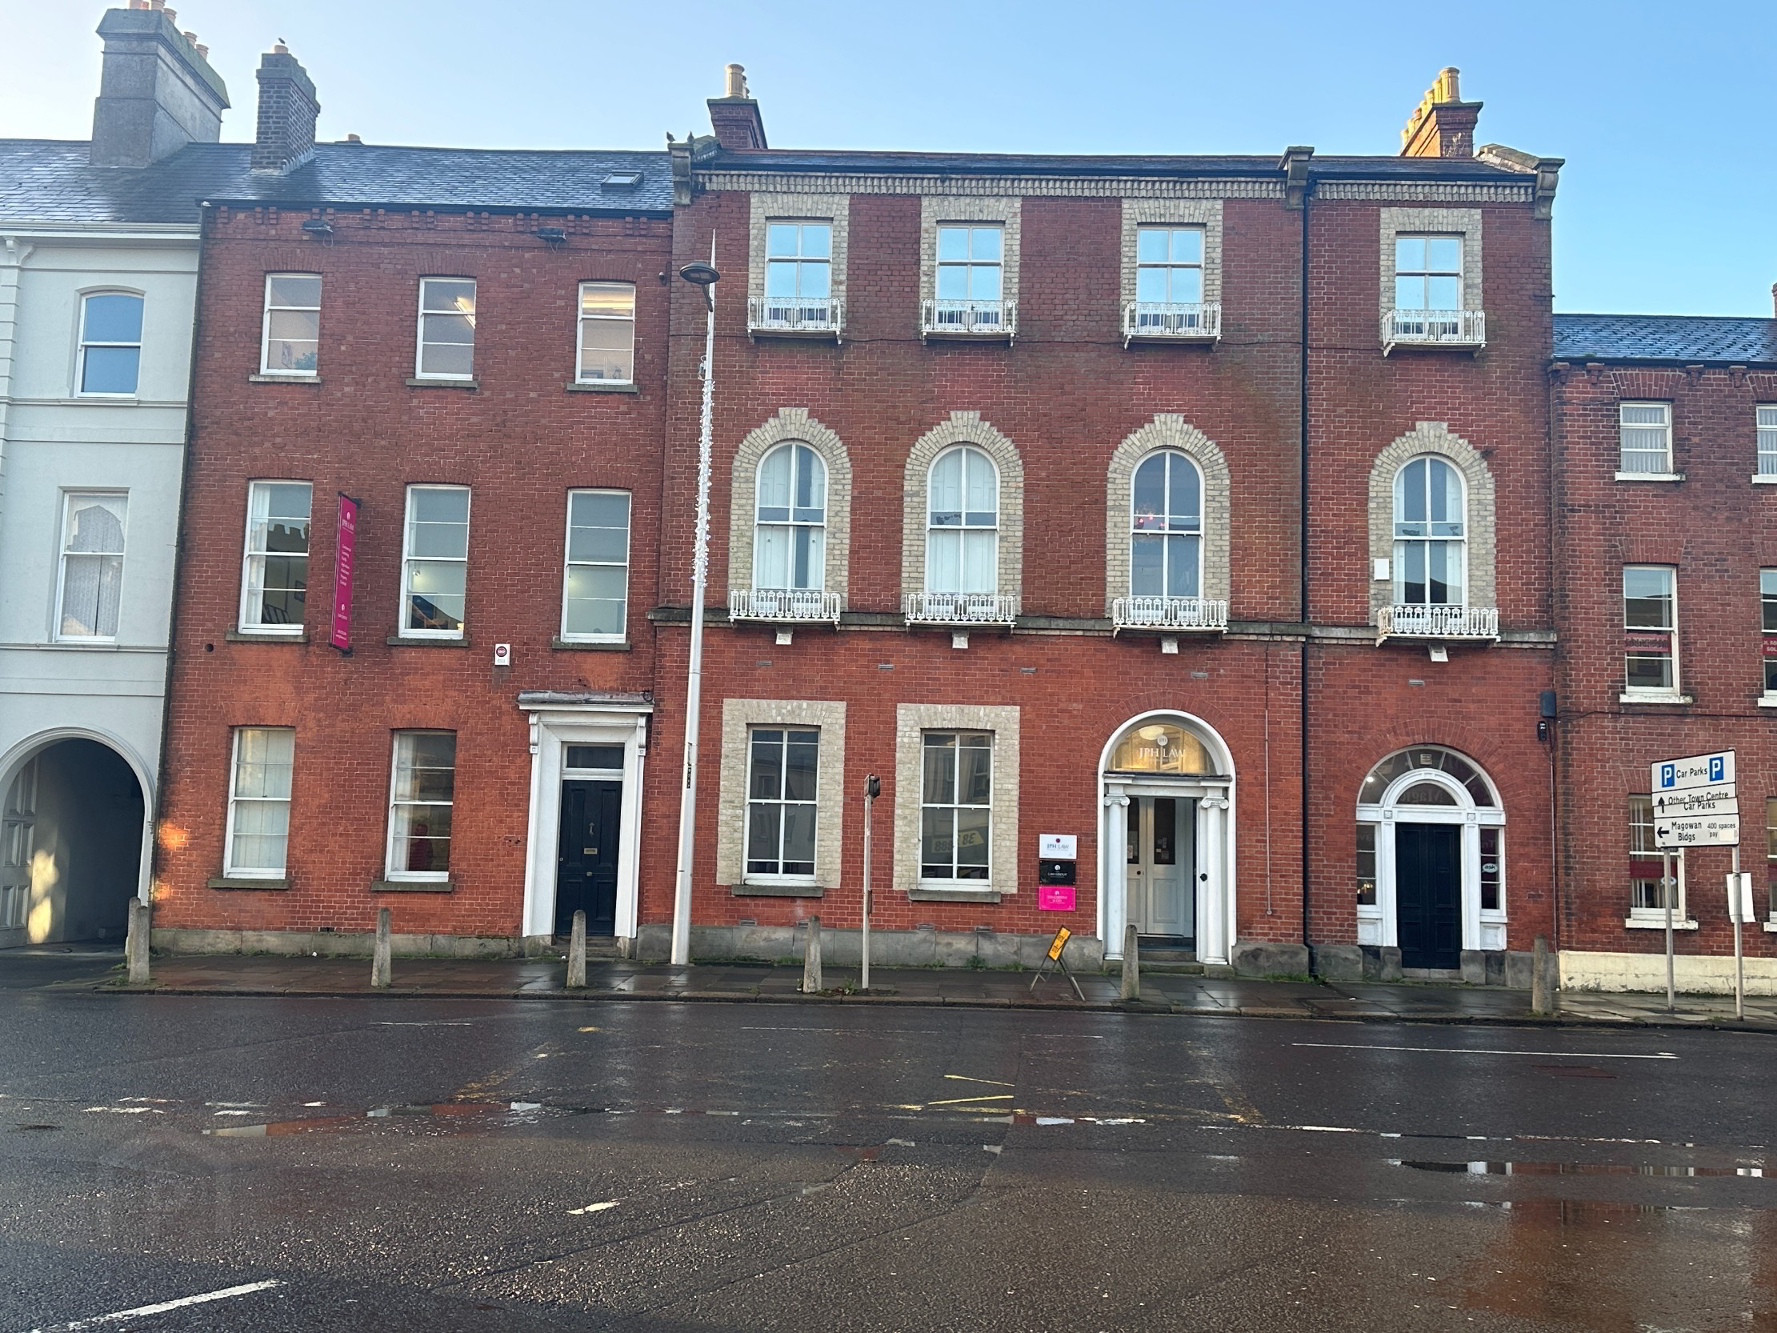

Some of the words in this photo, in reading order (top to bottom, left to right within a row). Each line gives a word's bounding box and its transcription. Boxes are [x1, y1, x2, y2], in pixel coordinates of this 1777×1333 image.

[1139, 747, 1159, 759] JPH
[1162, 748, 1186, 758] LAW
[1663, 766, 1672, 786] P
[1676, 769, 1688, 778] Car
[1690, 766, 1708, 776] Parks
[1712, 759, 1721, 779] P
[1668, 796, 1686, 805] Other
[1688, 794, 1704, 802] Town
[1706, 791, 1729, 800] Centre
[1684, 802, 1695, 810] Car
[1697, 800, 1716, 810] Parks
[1671, 821, 1702, 831] Magowan
[1678, 832, 1696, 842] Bldgs
